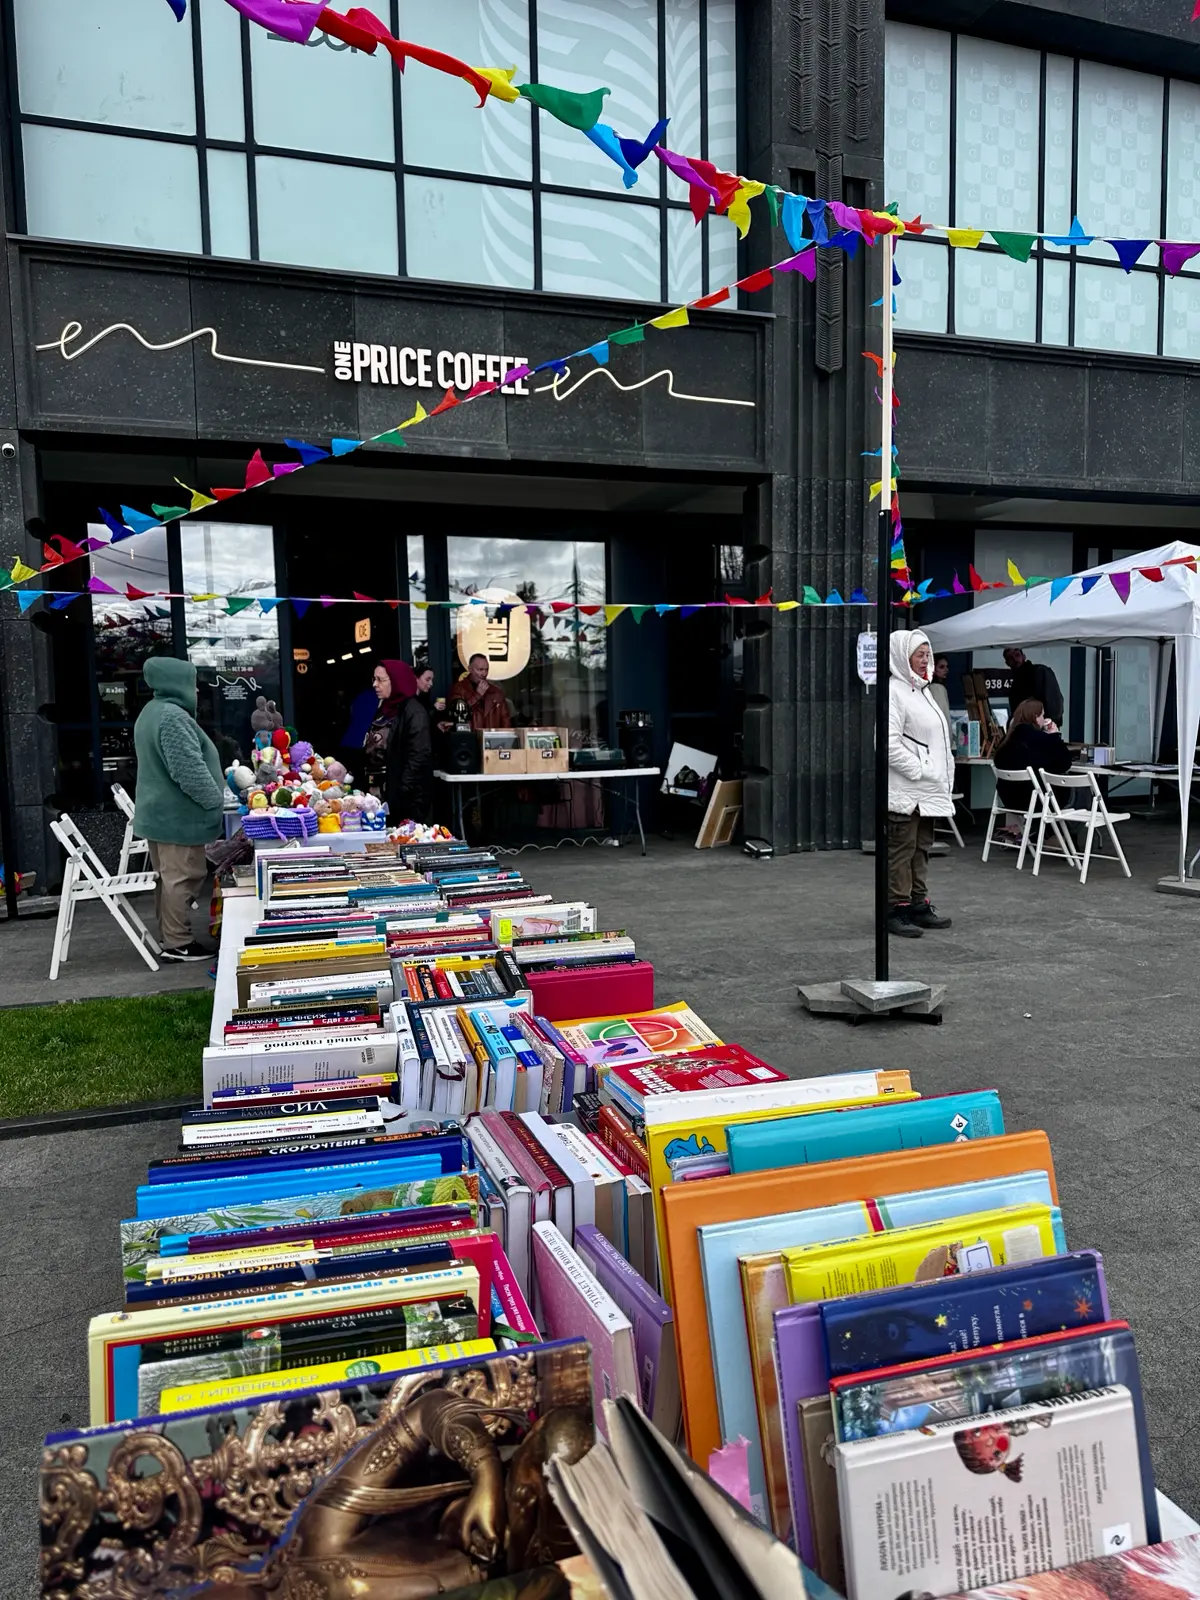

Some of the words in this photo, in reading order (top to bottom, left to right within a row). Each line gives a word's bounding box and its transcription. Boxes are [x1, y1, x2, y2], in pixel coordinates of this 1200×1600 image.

[334, 341, 352, 380] ONE
[353, 342, 433, 388] PRICE
[985, 679, 1002, 689] 938
[264, 1039, 323, 1051] гардероб
[327, 1036, 369, 1046] умный
[280, 1101, 328, 1114] СИЛ
[269, 1139, 367, 1155] СКОРОЧТЕНИЕ
[542, 1229, 557, 1248] ЛЕДИ
[300, 1258, 319, 1266] 100
[555, 1248, 570, 1266] ЮНОЙ
[162, 1272, 225, 1284] ЧЕВОСТИКА
[404, 1269, 463, 1283] Сказки
[567, 1265, 581, 1280] ДЛЯ
[236, 1285, 277, 1296] ФЛОРА
[312, 1280, 383, 1295] принцах
[580, 1279, 603, 1309] ЭТИКЕТ
[181, 1292, 288, 1313] принцессах
[291, 1308, 393, 1328] ТАИНСТВЕННЫЙ
[332, 1321, 357, 1329] САД
[994, 1305, 1004, 1341] помогла
[163, 1333, 221, 1347] ФРЭНСИС
[164, 1341, 221, 1354] БЕРНЕТТ
[200, 1374, 320, 1398] ГИППЕНРЕЙТЕР
[935, 1412, 992, 1429] ИСПАНСКИЙ
